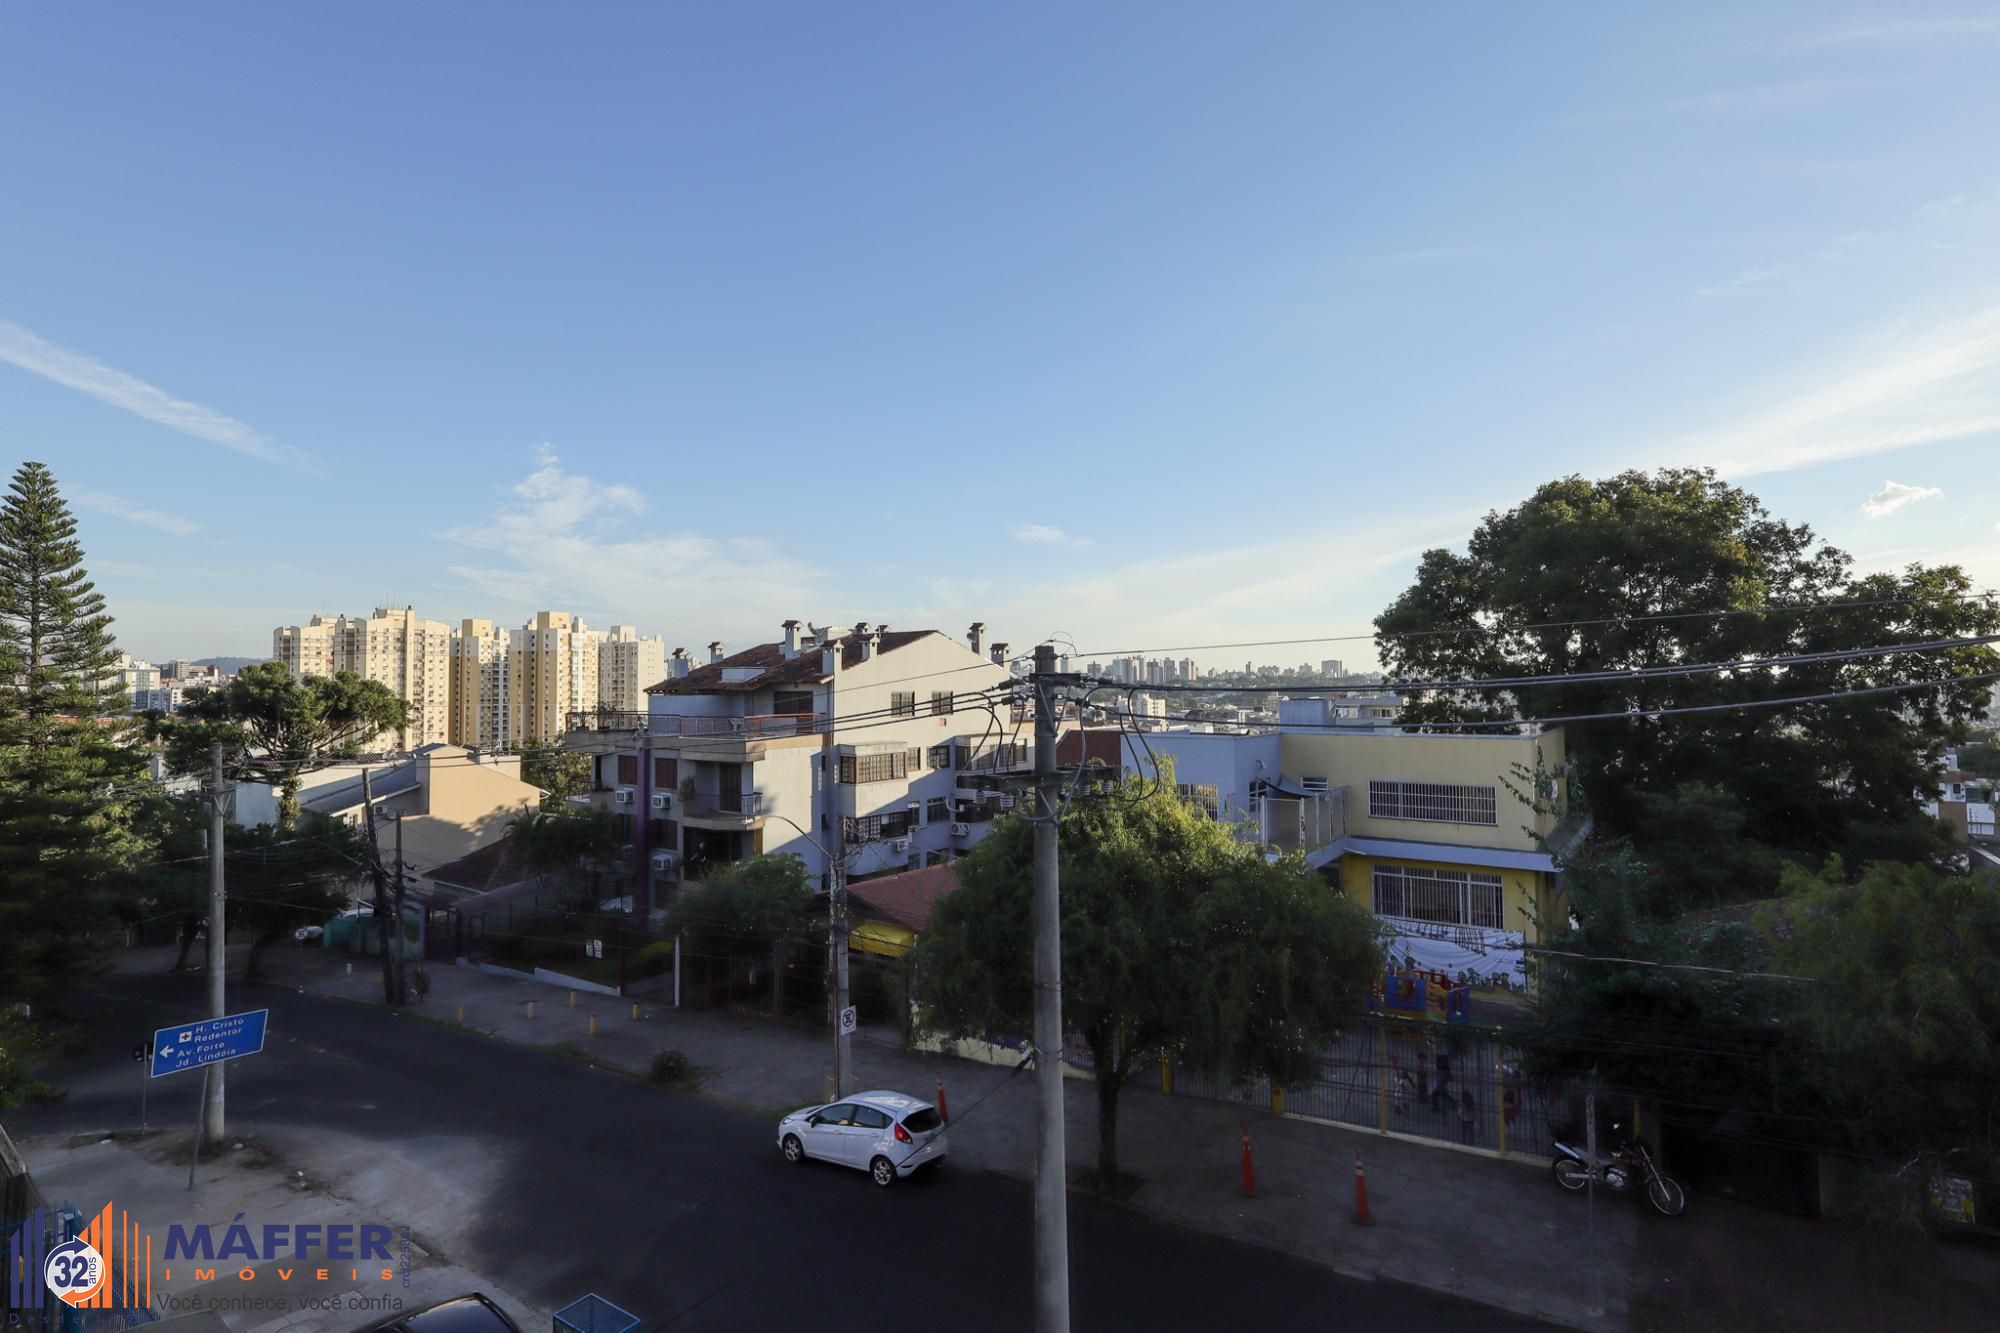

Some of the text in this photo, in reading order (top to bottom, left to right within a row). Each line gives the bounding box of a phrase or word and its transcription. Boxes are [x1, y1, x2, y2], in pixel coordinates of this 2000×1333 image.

[195, 1018, 244, 1034] H. Cristo
[194, 1028, 242, 1043] Redentor
[176, 1048, 236, 1068] Jd. Lindóia
